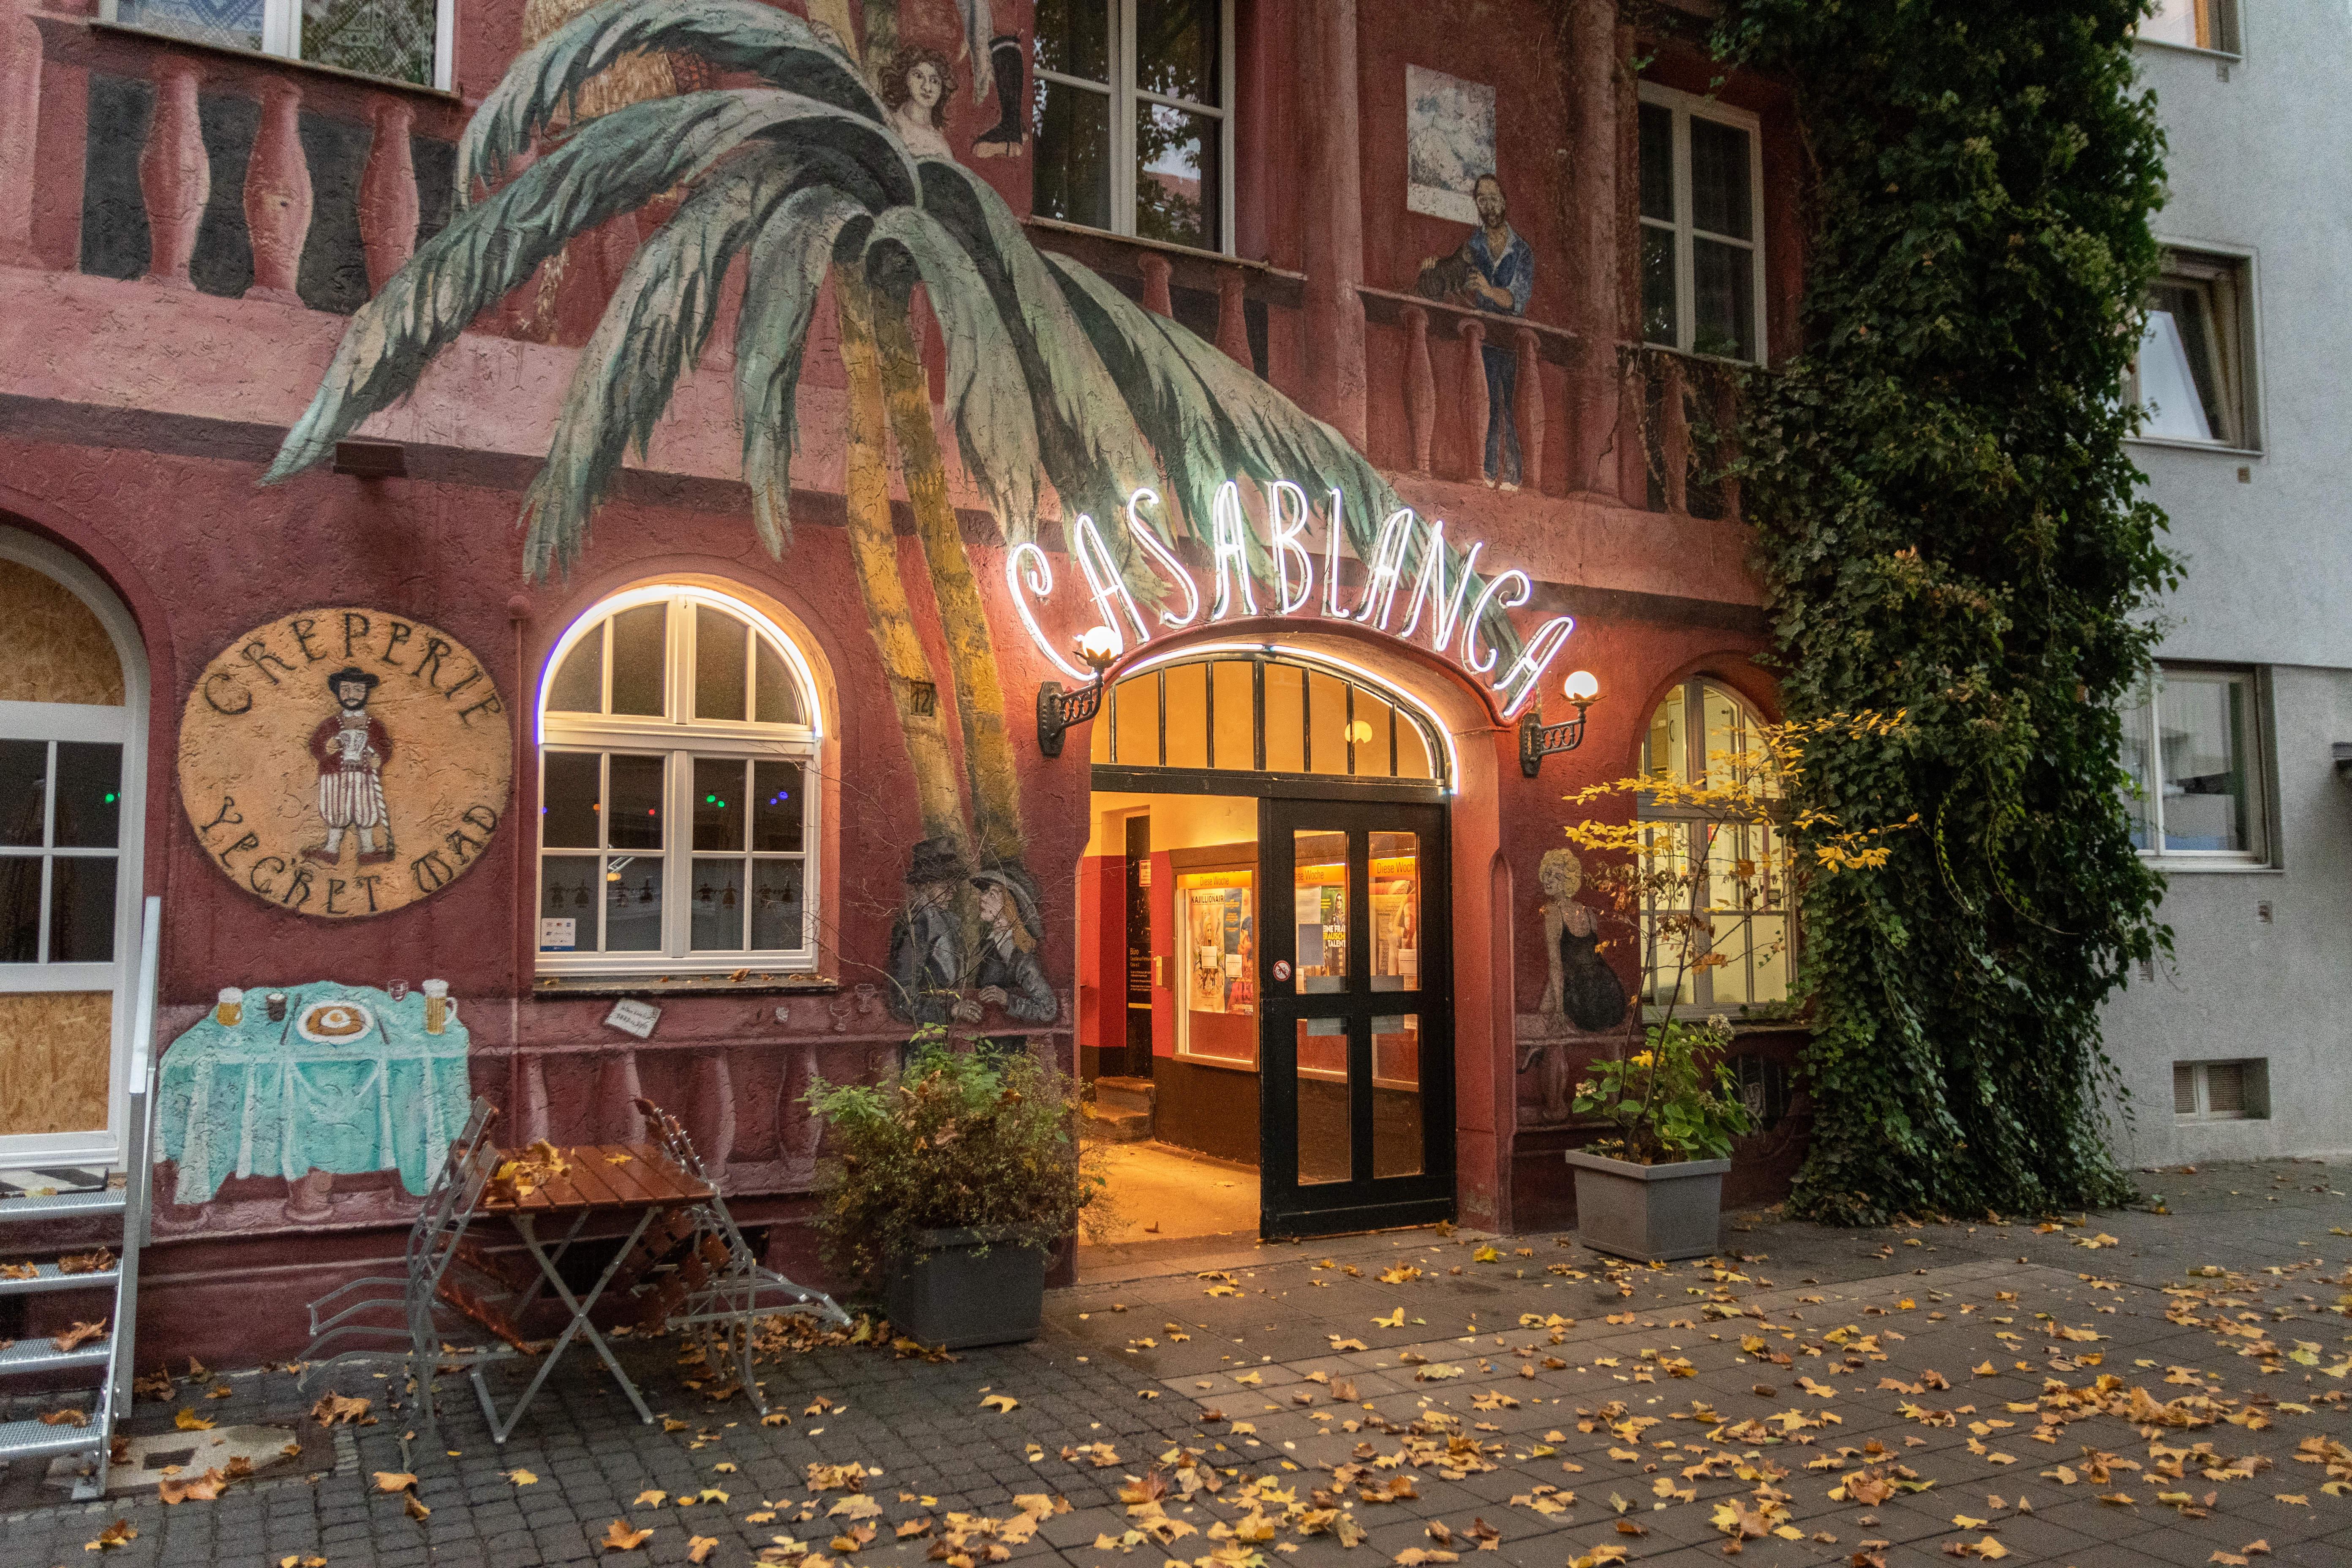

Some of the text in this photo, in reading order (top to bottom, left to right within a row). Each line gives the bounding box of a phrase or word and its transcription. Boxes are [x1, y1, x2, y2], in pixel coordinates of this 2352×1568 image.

[1006, 479, 1576, 717] CASABLANCA
[205, 612, 502, 727] CREPERIE
[911, 688, 930, 713] 12
[410, 805, 498, 893] MAD
[1295, 870, 1324, 881] ese Woche
[1377, 863, 1394, 874] Diese
[1200, 876, 1229, 886] Diese Woche
[1191, 895, 1224, 903] KAJILLIONAIR
